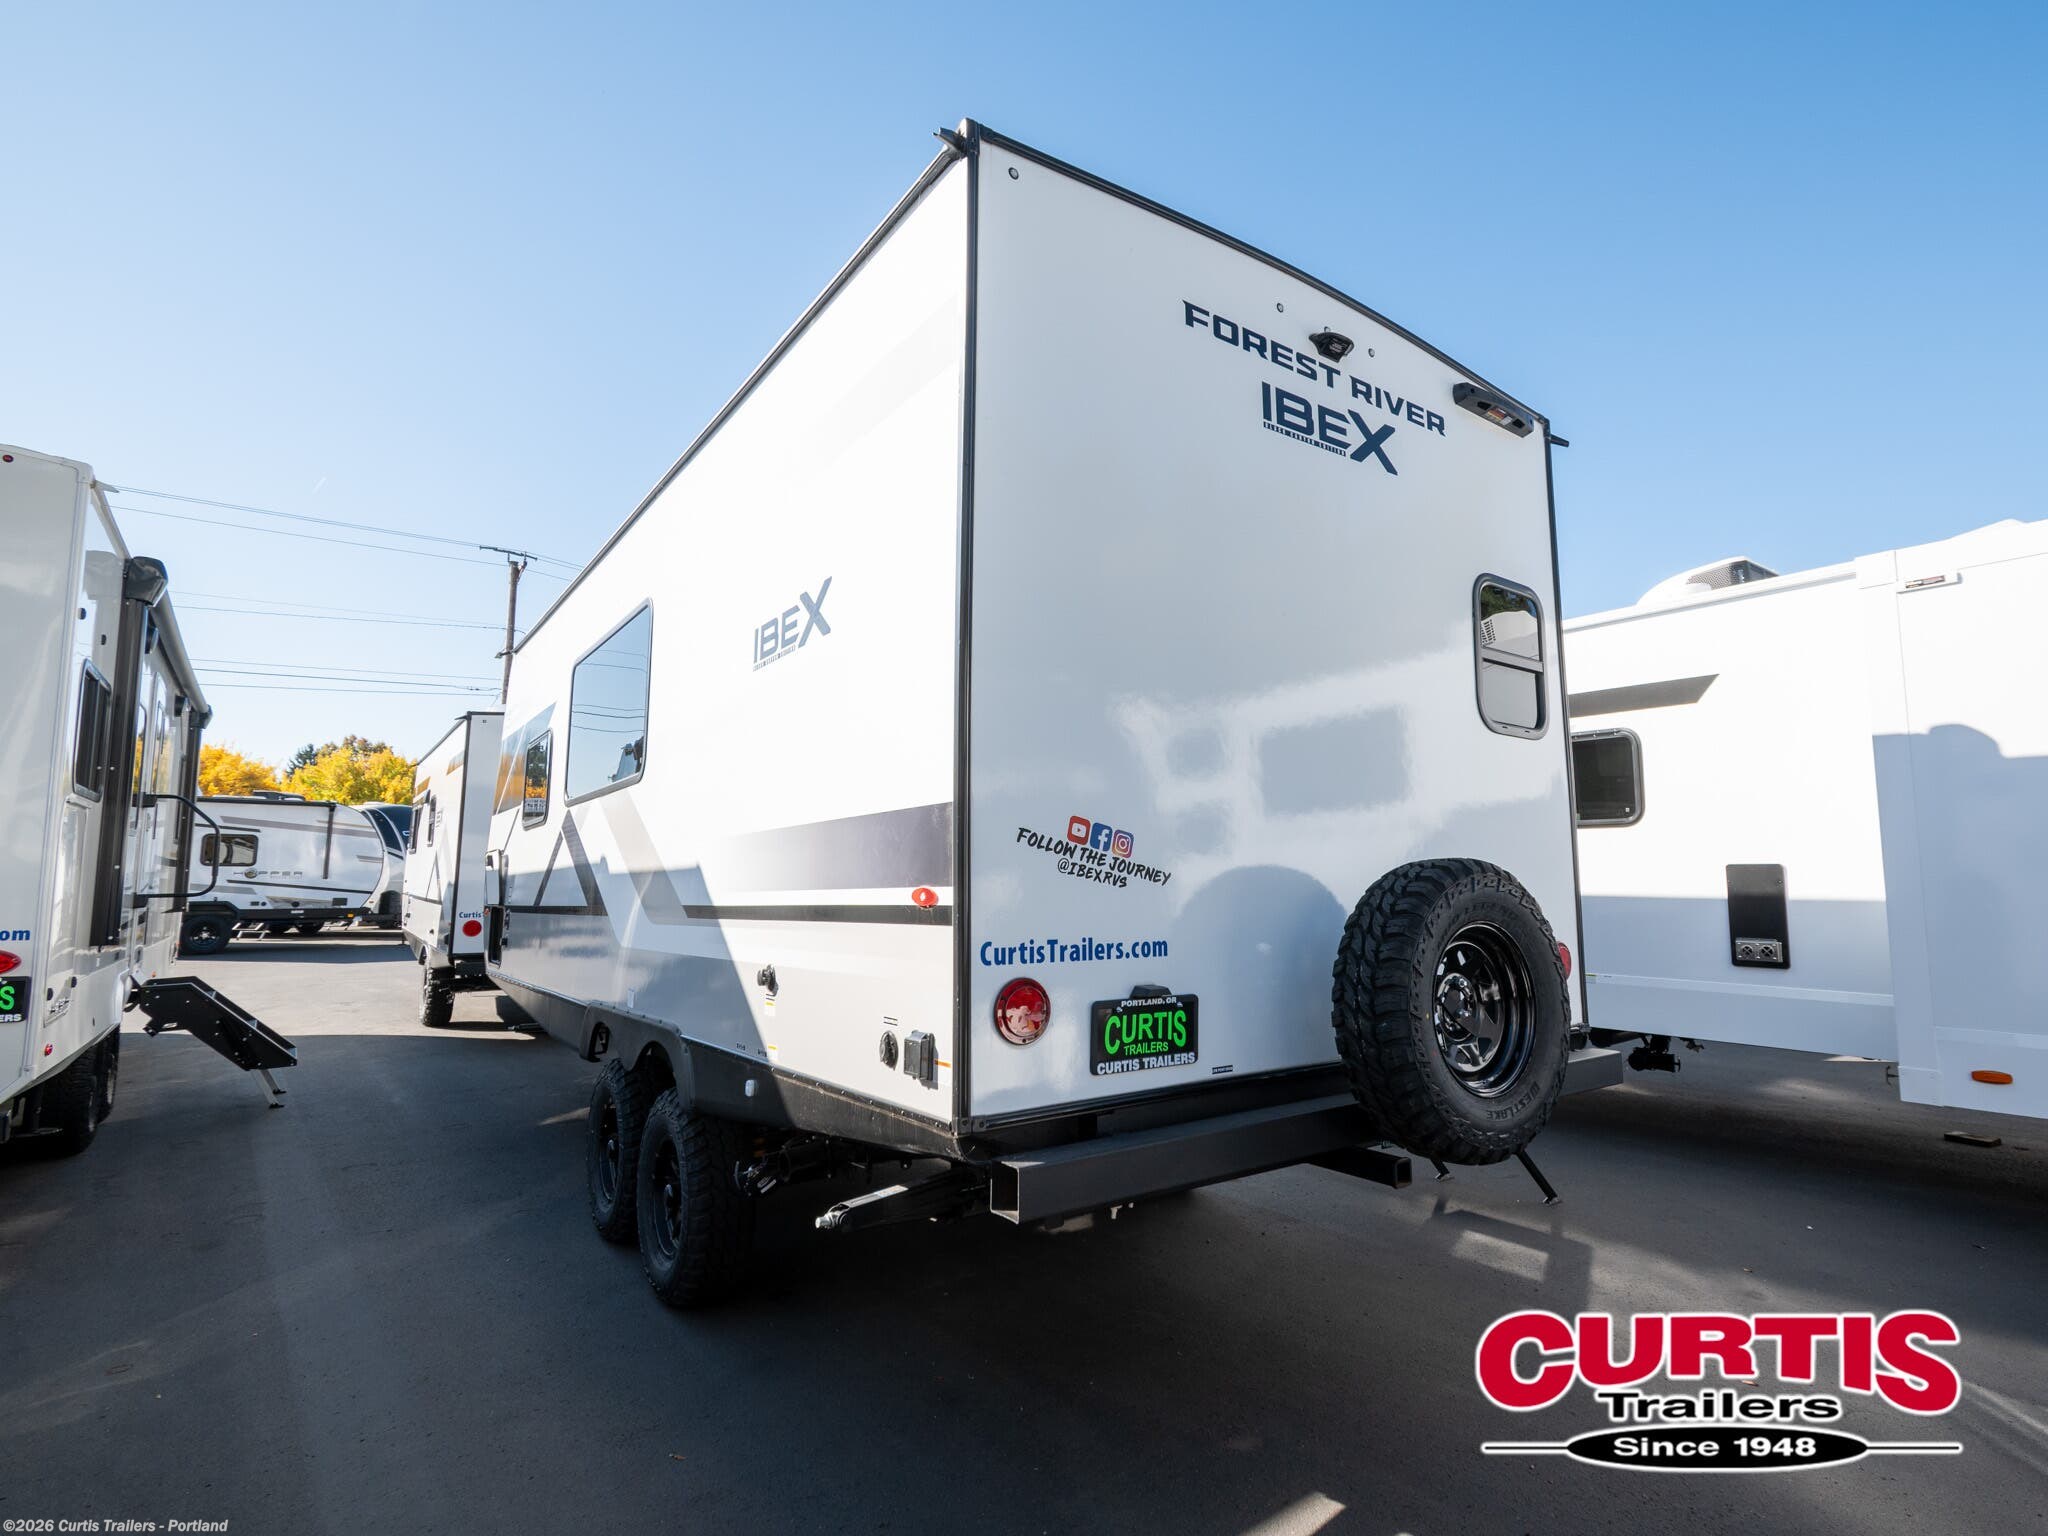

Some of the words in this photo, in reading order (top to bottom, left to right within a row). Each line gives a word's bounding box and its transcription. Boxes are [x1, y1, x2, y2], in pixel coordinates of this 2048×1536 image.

[1182, 300, 1341, 389] FOREST
[1349, 375, 1446, 437] RIVER
[1262, 381, 1398, 476] IBEX
[753, 575, 833, 664] IBEX
[1016, 827, 1078, 859] FOLLOW
[1080, 847, 1107, 867] THE
[1109, 856, 1172, 886] JOURNEY
[980, 937, 1169, 966] CurtisTrailers.com
[1166, 996, 1177, 1004] OR
[1104, 1009, 1187, 1055] CURTIS
[1124, 1041, 1169, 1056] TRAILERS
[1096, 1058, 1140, 1075] CURTIS
[1142, 1052, 1196, 1069] TRAILERS
